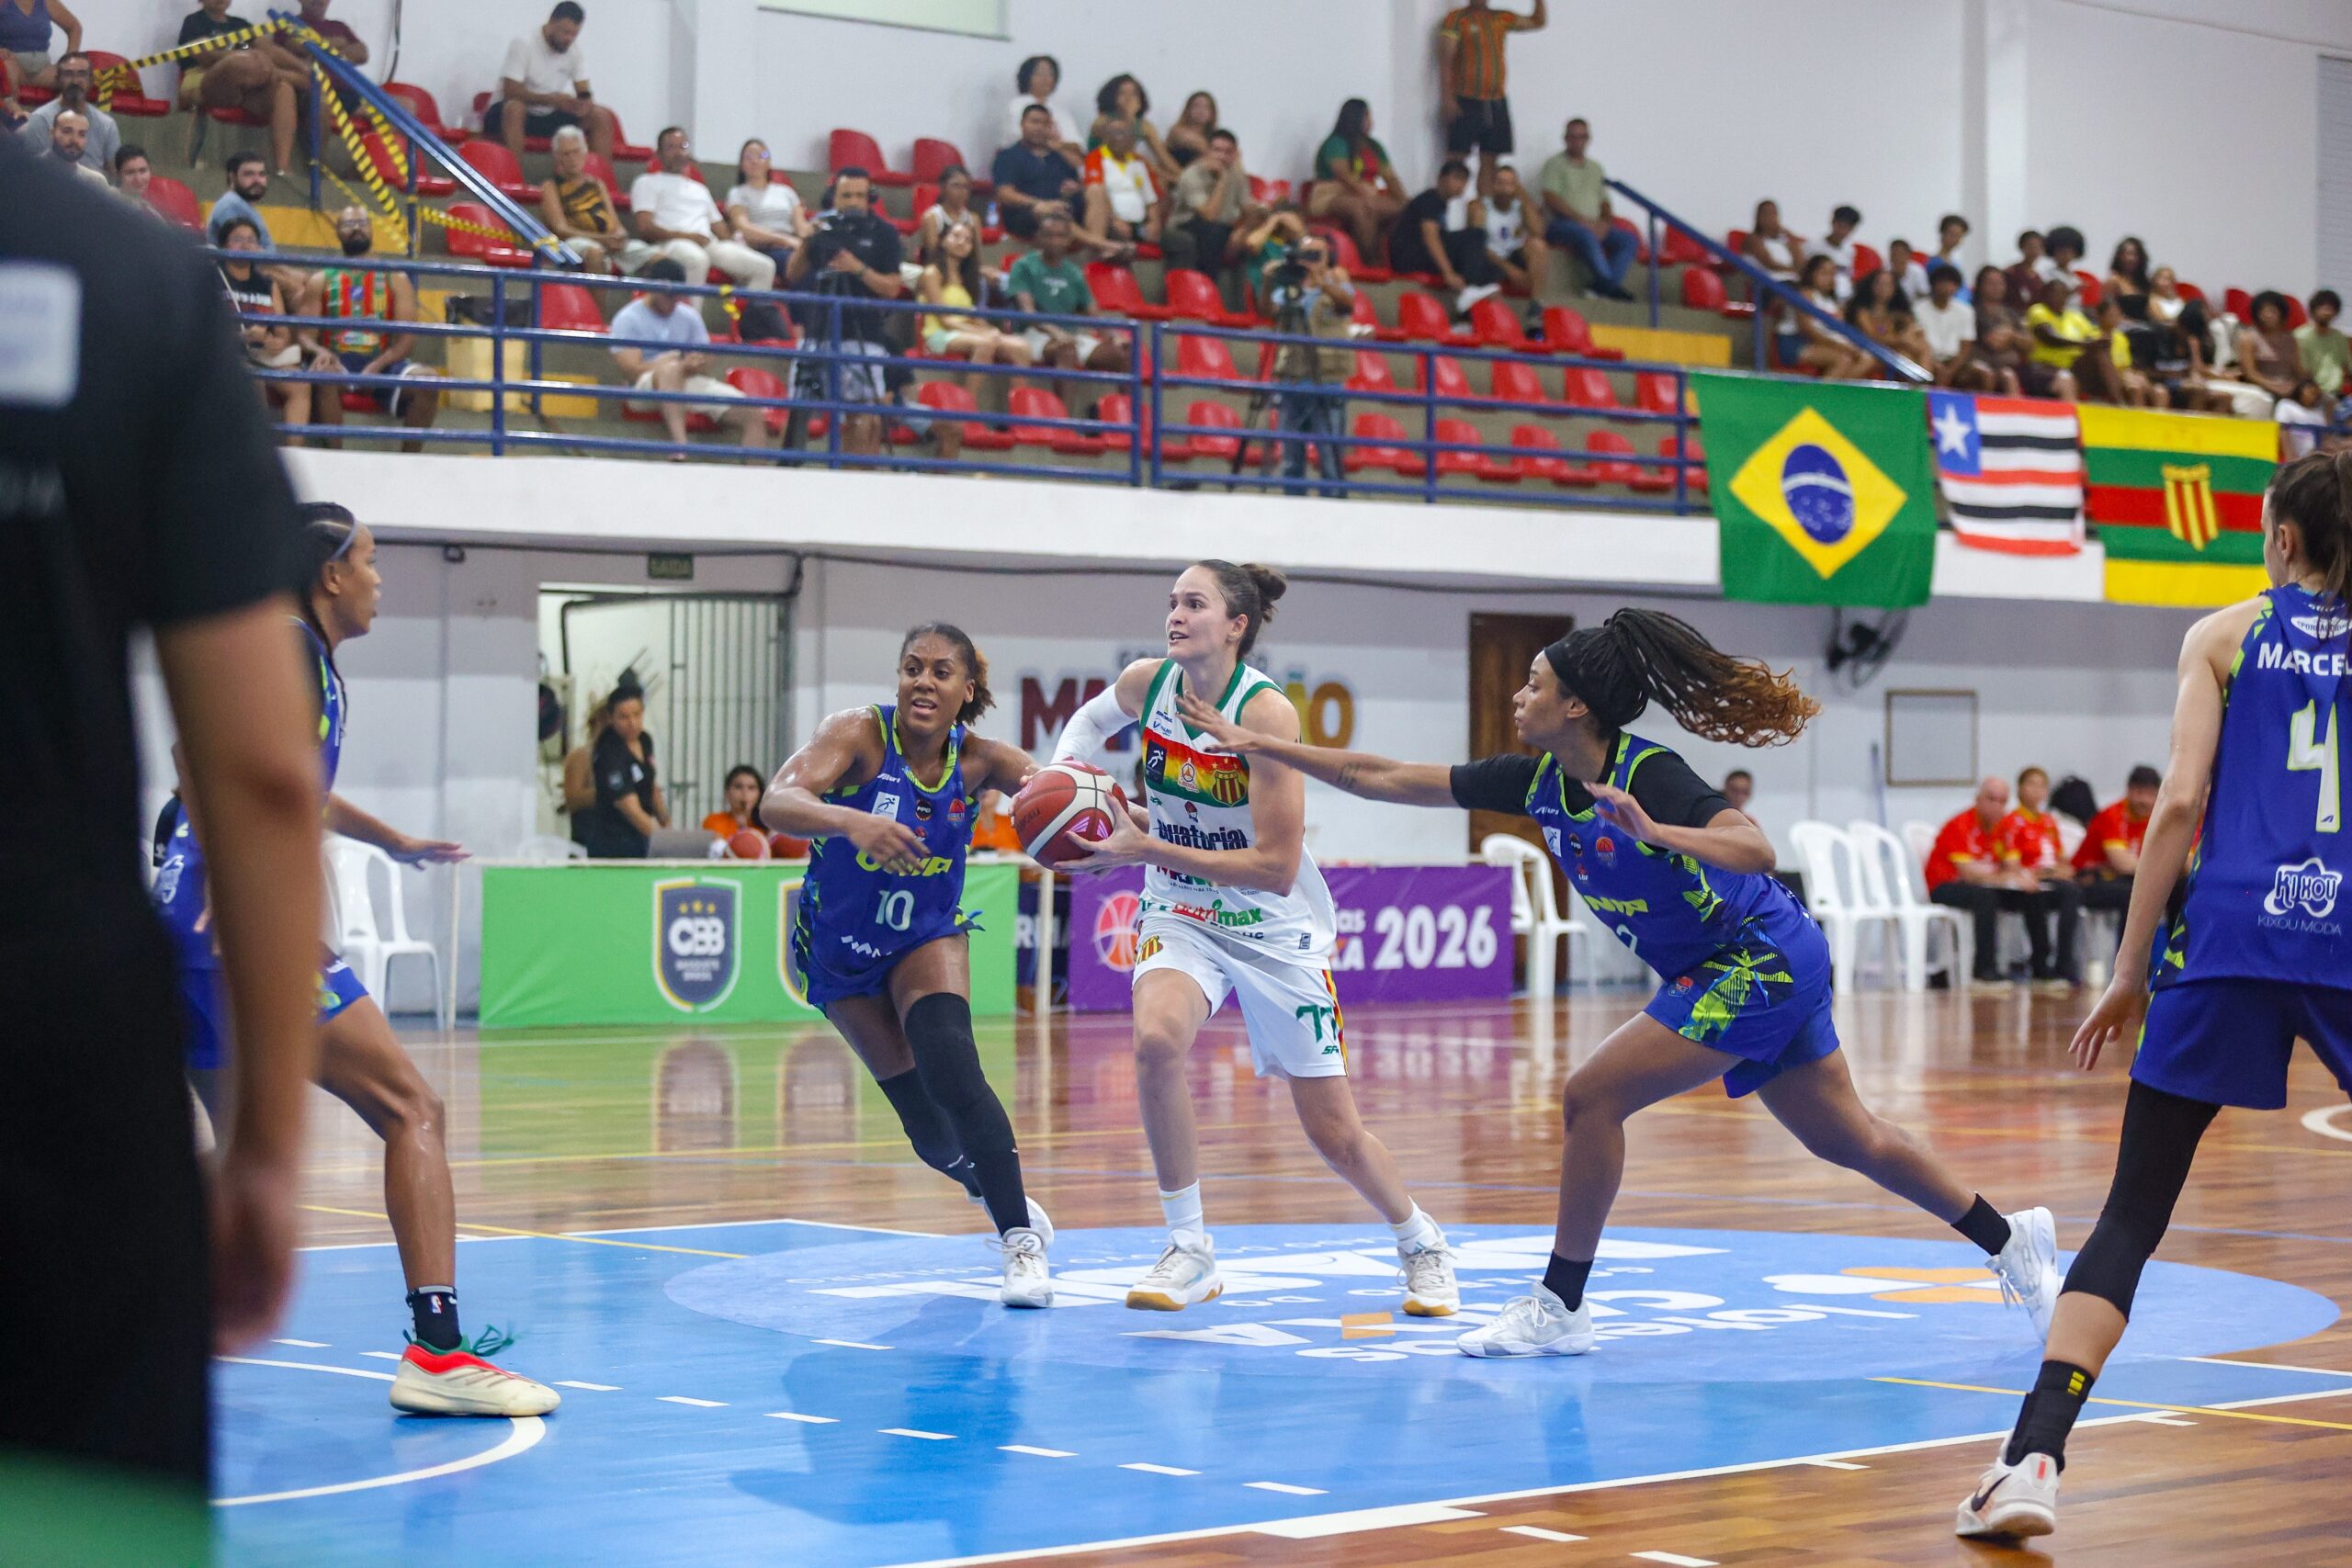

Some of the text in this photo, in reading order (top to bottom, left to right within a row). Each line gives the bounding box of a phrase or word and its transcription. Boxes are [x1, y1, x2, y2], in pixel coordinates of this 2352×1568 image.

[2286, 699, 2341, 833] 4
[855, 851, 954, 877] UIP
[875, 889, 915, 931] 10
[1582, 895, 1649, 918] NIP
[2275, 870, 2337, 909] KIXOU
[668, 916, 726, 957] CBB
[1373, 903, 1498, 971] 2026
[2257, 914, 2343, 937] KIXOU MODA
[1295, 1303, 1921, 1362] loteas
